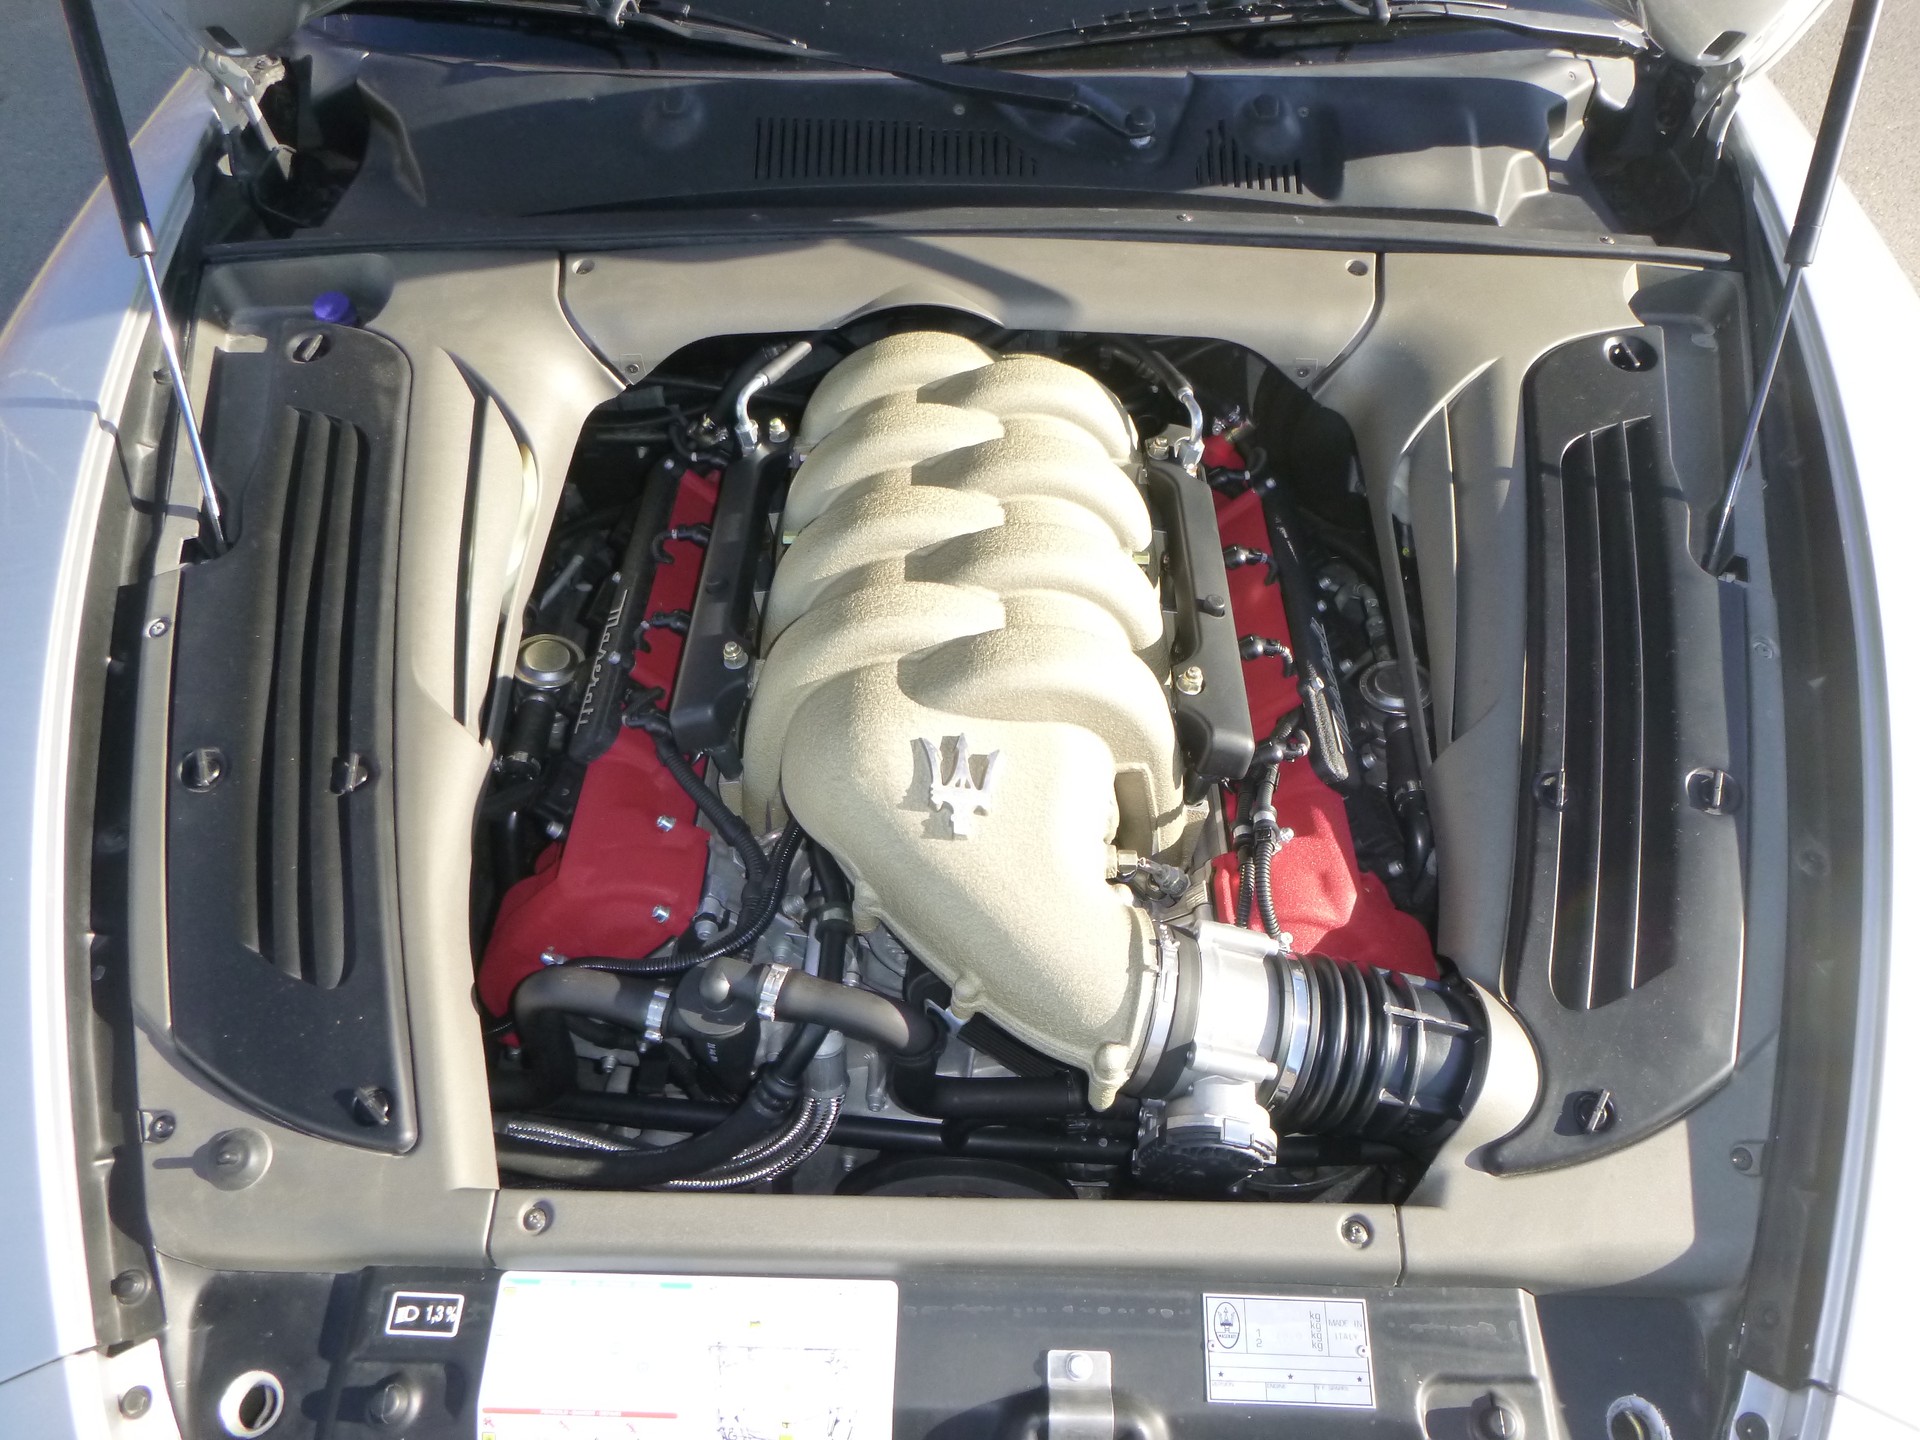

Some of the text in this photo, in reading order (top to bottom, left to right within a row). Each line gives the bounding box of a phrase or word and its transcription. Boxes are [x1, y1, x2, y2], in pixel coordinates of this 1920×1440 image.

[1309, 1310, 1321, 1322] kg
[1310, 1320, 1321, 1332] kg
[1328, 1319, 1362, 1328] MADE IN
[1311, 1330, 1322, 1342] kg
[1335, 1332, 1358, 1340] ITALY
[1256, 1338, 1263, 1348] 2
[1311, 1340, 1323, 1352] kg
